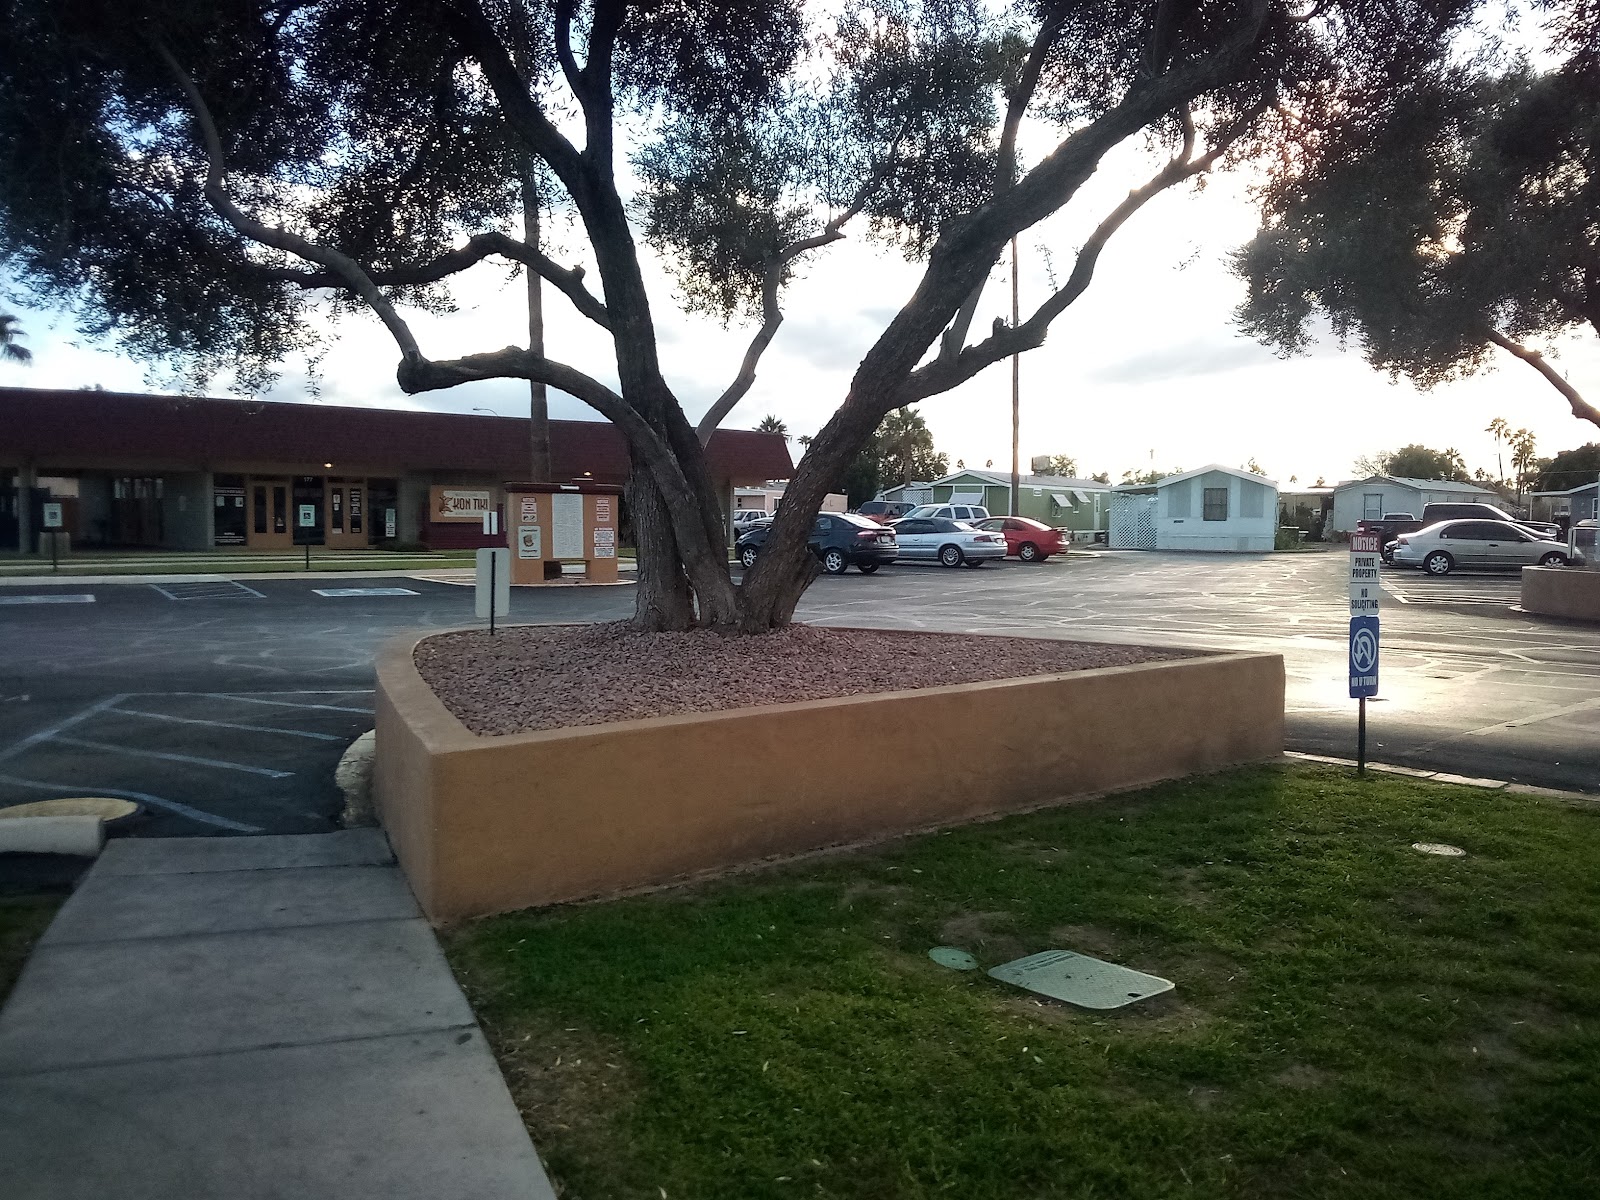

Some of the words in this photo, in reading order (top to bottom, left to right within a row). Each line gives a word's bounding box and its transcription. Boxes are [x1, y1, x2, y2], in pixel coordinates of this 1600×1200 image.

[452, 498, 471, 510] KON
[473, 498, 488, 510] TIKI
[1352, 536, 1378, 551] NOTICE
[1355, 558, 1375, 567] PRIVATE
[1352, 569, 1378, 579] PROPERTY
[1361, 589, 1368, 598] NO
[1351, 600, 1379, 610] SOLICITING
[1351, 677, 1358, 687] NO
